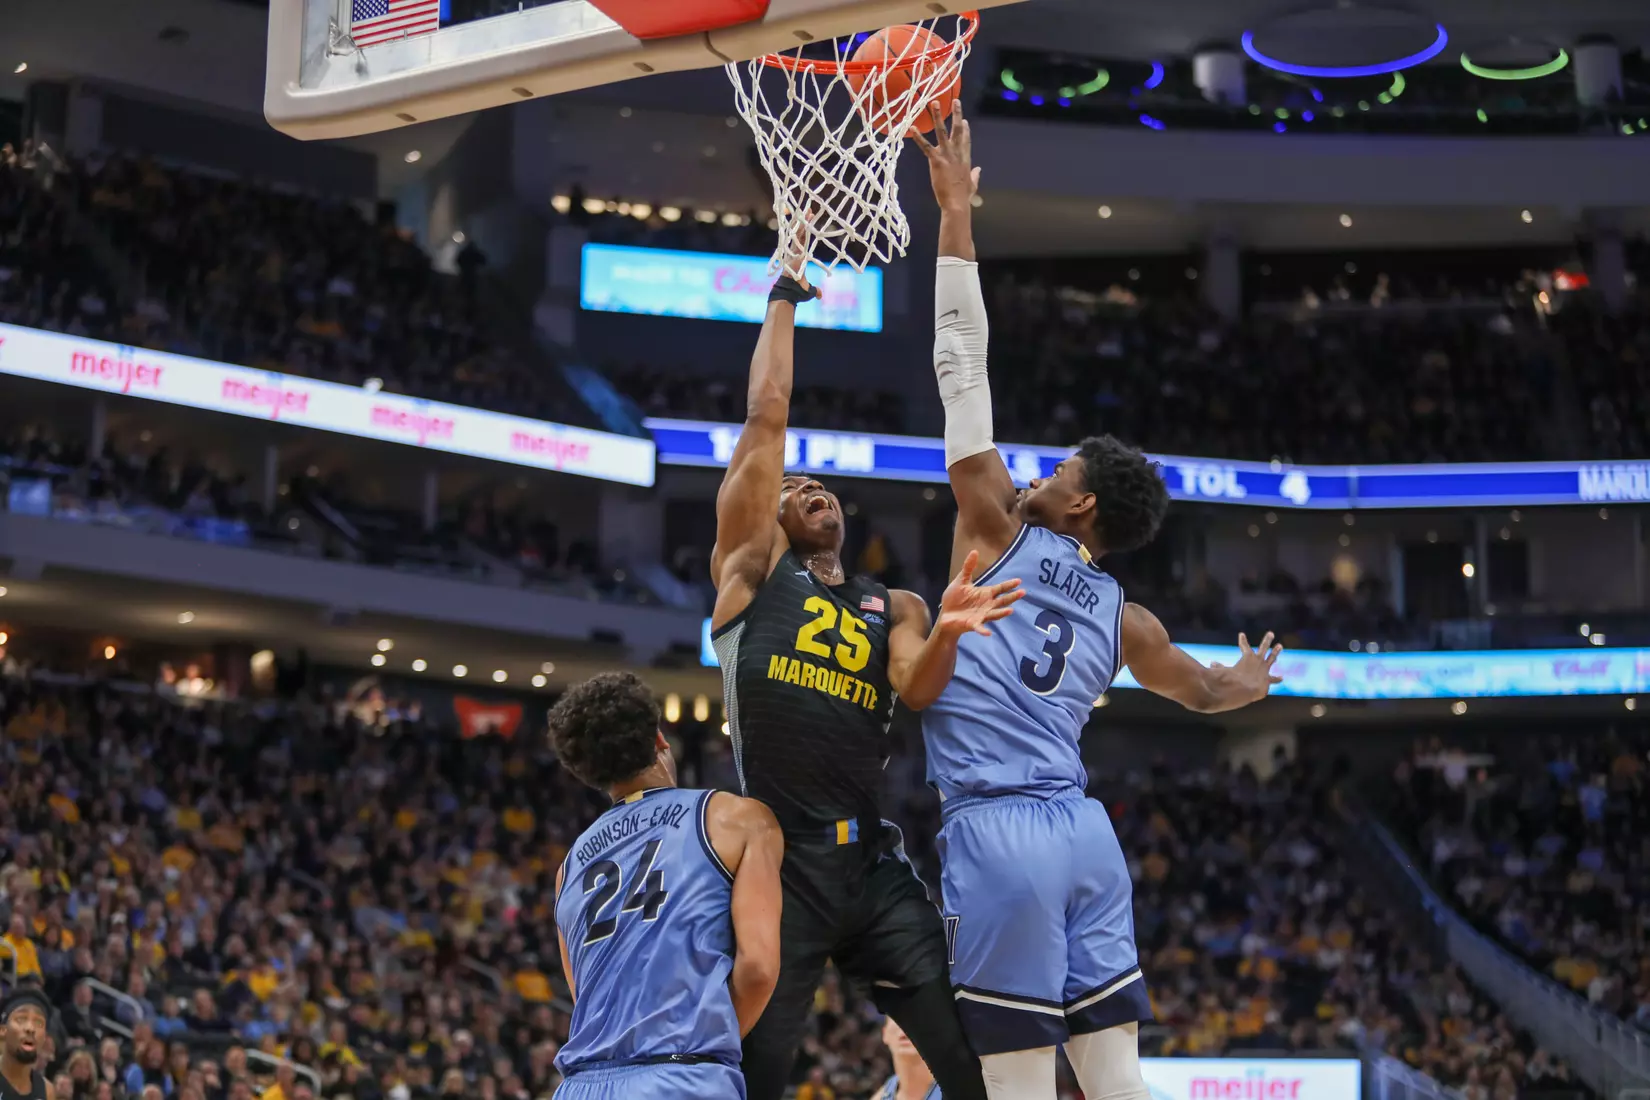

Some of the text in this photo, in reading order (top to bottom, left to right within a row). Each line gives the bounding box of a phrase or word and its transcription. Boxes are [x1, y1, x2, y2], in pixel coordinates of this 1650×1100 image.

[70, 344, 164, 393] meijer
[221, 371, 309, 420] meijer
[805, 433, 874, 472] PM
[1179, 463, 1311, 505] TOL 4
[1038, 558, 1100, 615] SLATER
[795, 595, 872, 673] 25
[1020, 609, 1076, 696] 3
[767, 654, 878, 710] MARQUETTE
[576, 803, 690, 867] ROBINSON-EARL
[582, 839, 669, 947] 24
[1190, 1068, 1302, 1100] meijer
